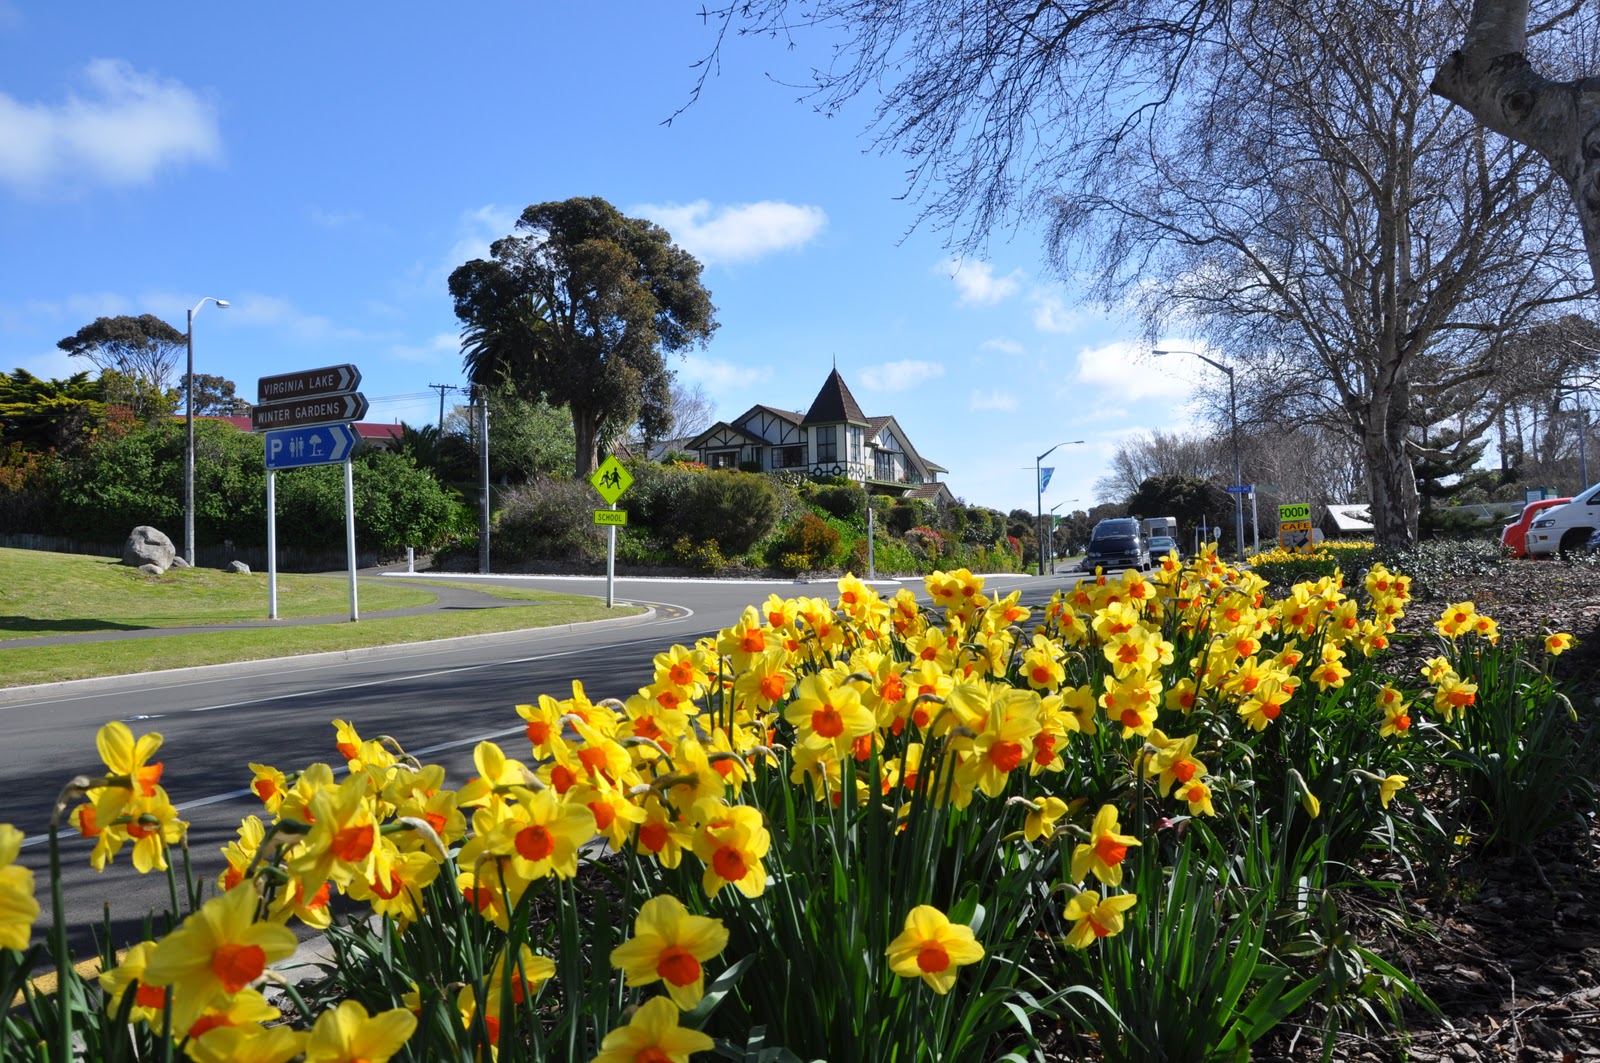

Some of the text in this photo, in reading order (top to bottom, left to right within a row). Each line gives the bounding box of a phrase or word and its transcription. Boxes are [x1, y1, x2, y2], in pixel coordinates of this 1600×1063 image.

[264, 374, 334, 395] VIRGINIA LAKE
[258, 402, 340, 423] WINTER GARDENS
[271, 439, 283, 460] P
[598, 513, 622, 522] SCHOOL
[1280, 506, 1304, 518] FOOD
[1281, 522, 1310, 531] CAFE
